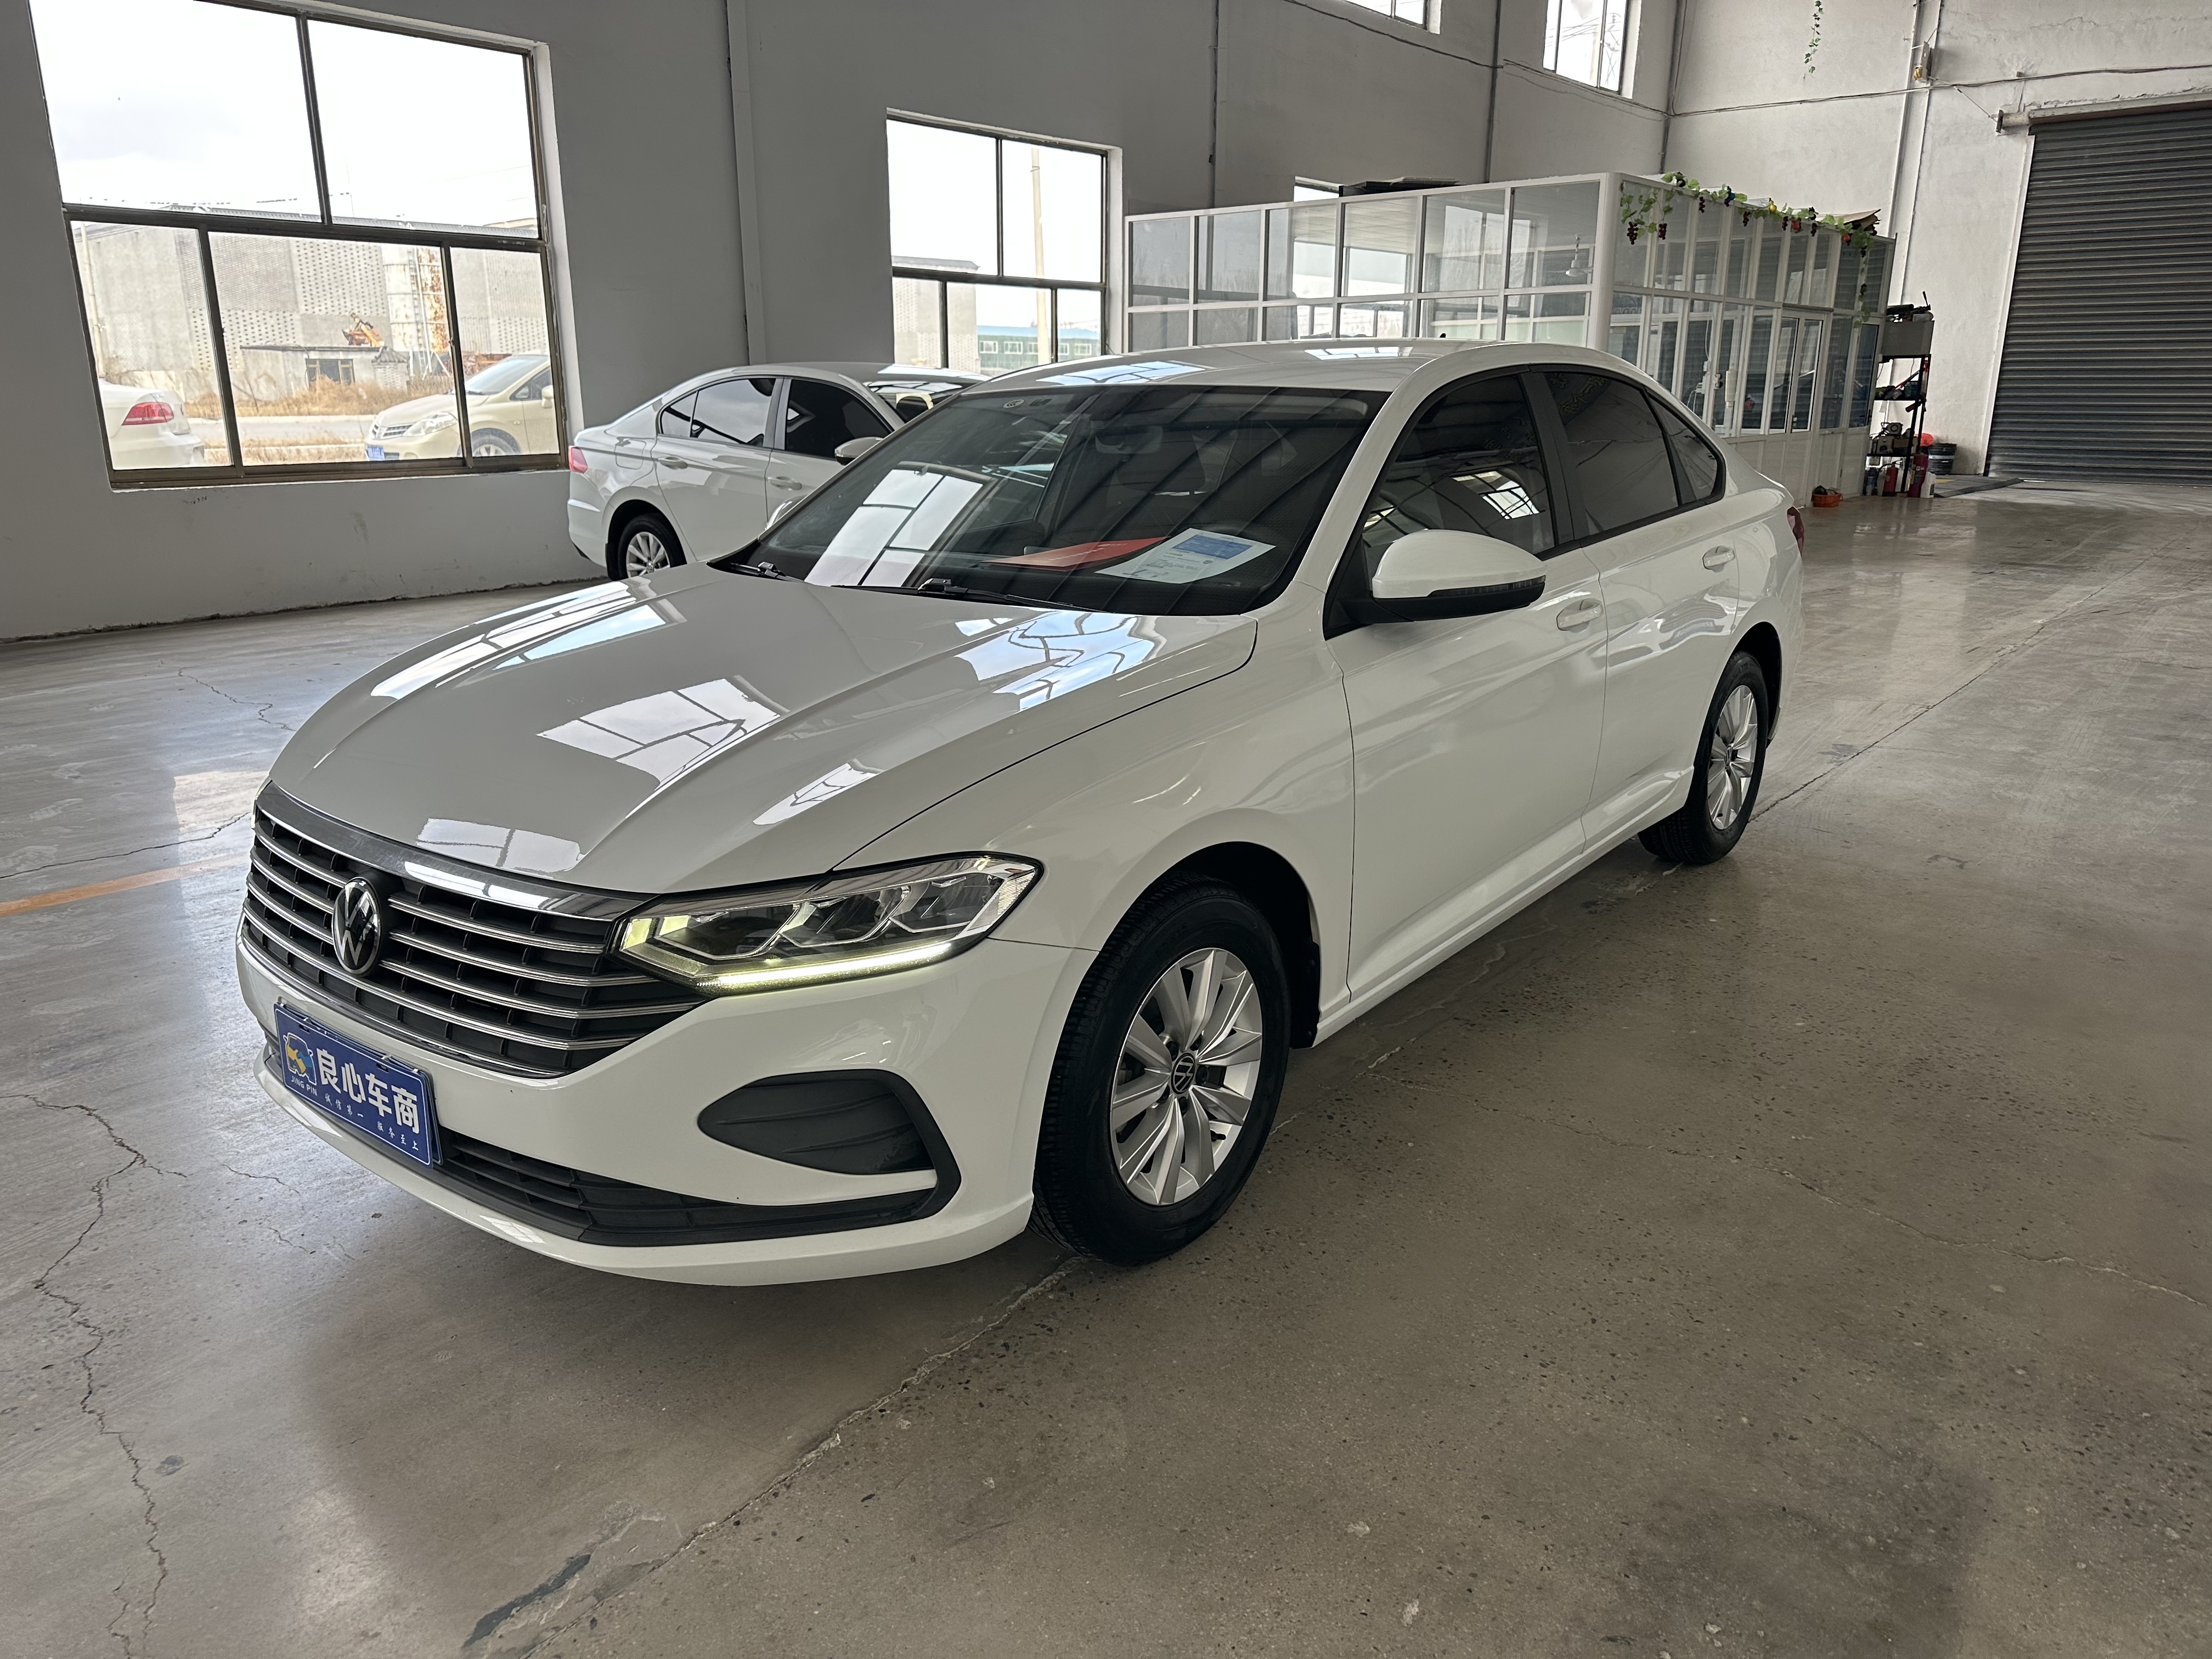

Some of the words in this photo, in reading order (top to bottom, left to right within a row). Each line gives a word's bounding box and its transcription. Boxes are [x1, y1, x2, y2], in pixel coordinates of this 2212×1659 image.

[291, 1075, 305, 1089] JING
[306, 1084, 318, 1096] PIN
[317, 1048, 420, 1134] 良心车商
[377, 1121, 419, 1151] 服务至上
